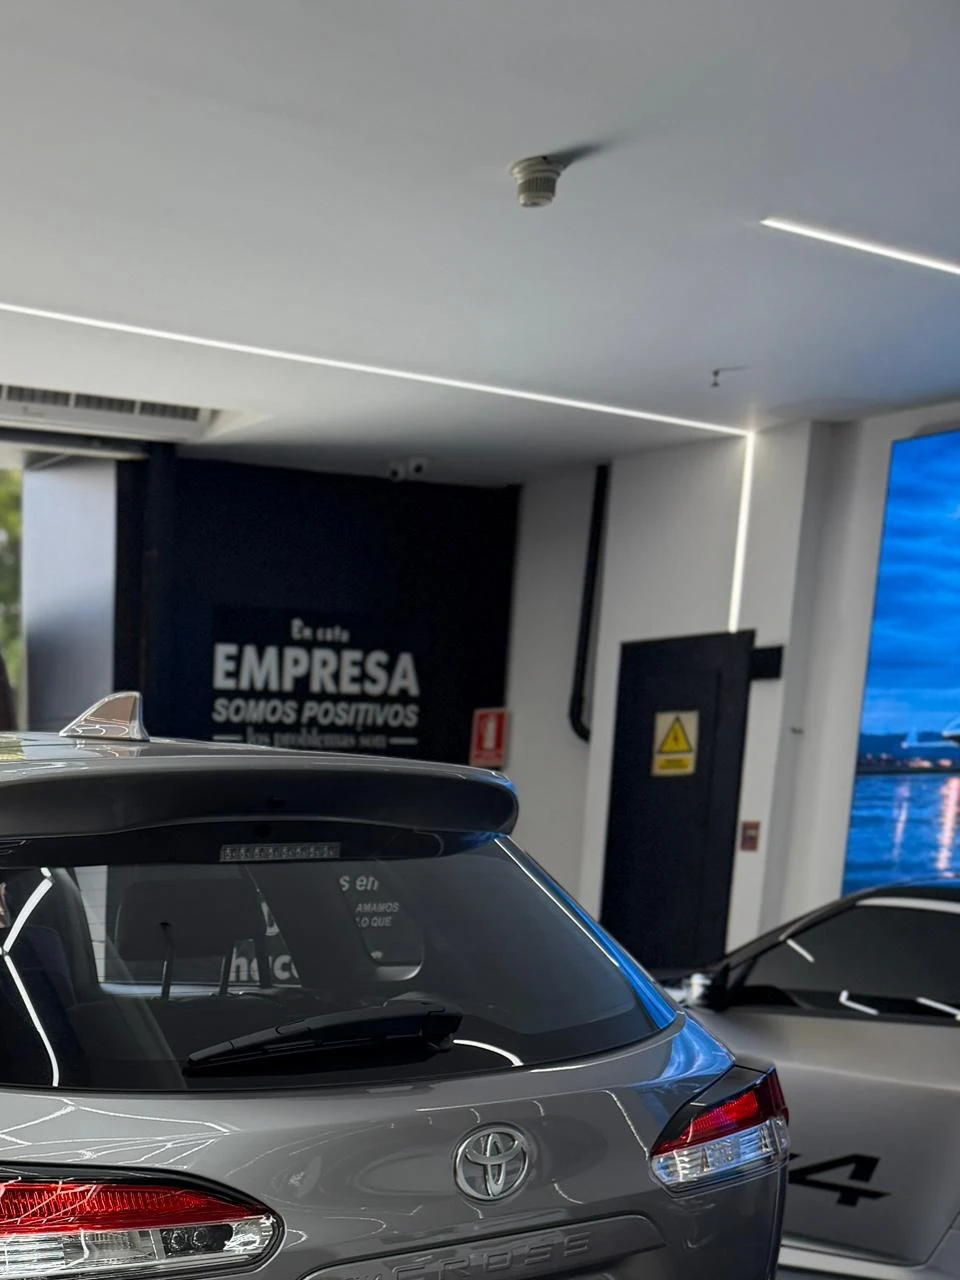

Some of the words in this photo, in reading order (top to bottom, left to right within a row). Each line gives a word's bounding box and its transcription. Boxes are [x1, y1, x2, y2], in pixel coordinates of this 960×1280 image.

[290, 617, 313, 640] En
[212, 642, 420, 697] EMPRESA
[212, 696, 299, 725] SOMOS
[300, 699, 420, 732] POSITIVOS
[355, 874, 379, 892] en
[355, 902, 400, 913] AMAMOS
[371, 916, 393, 928] QUE
